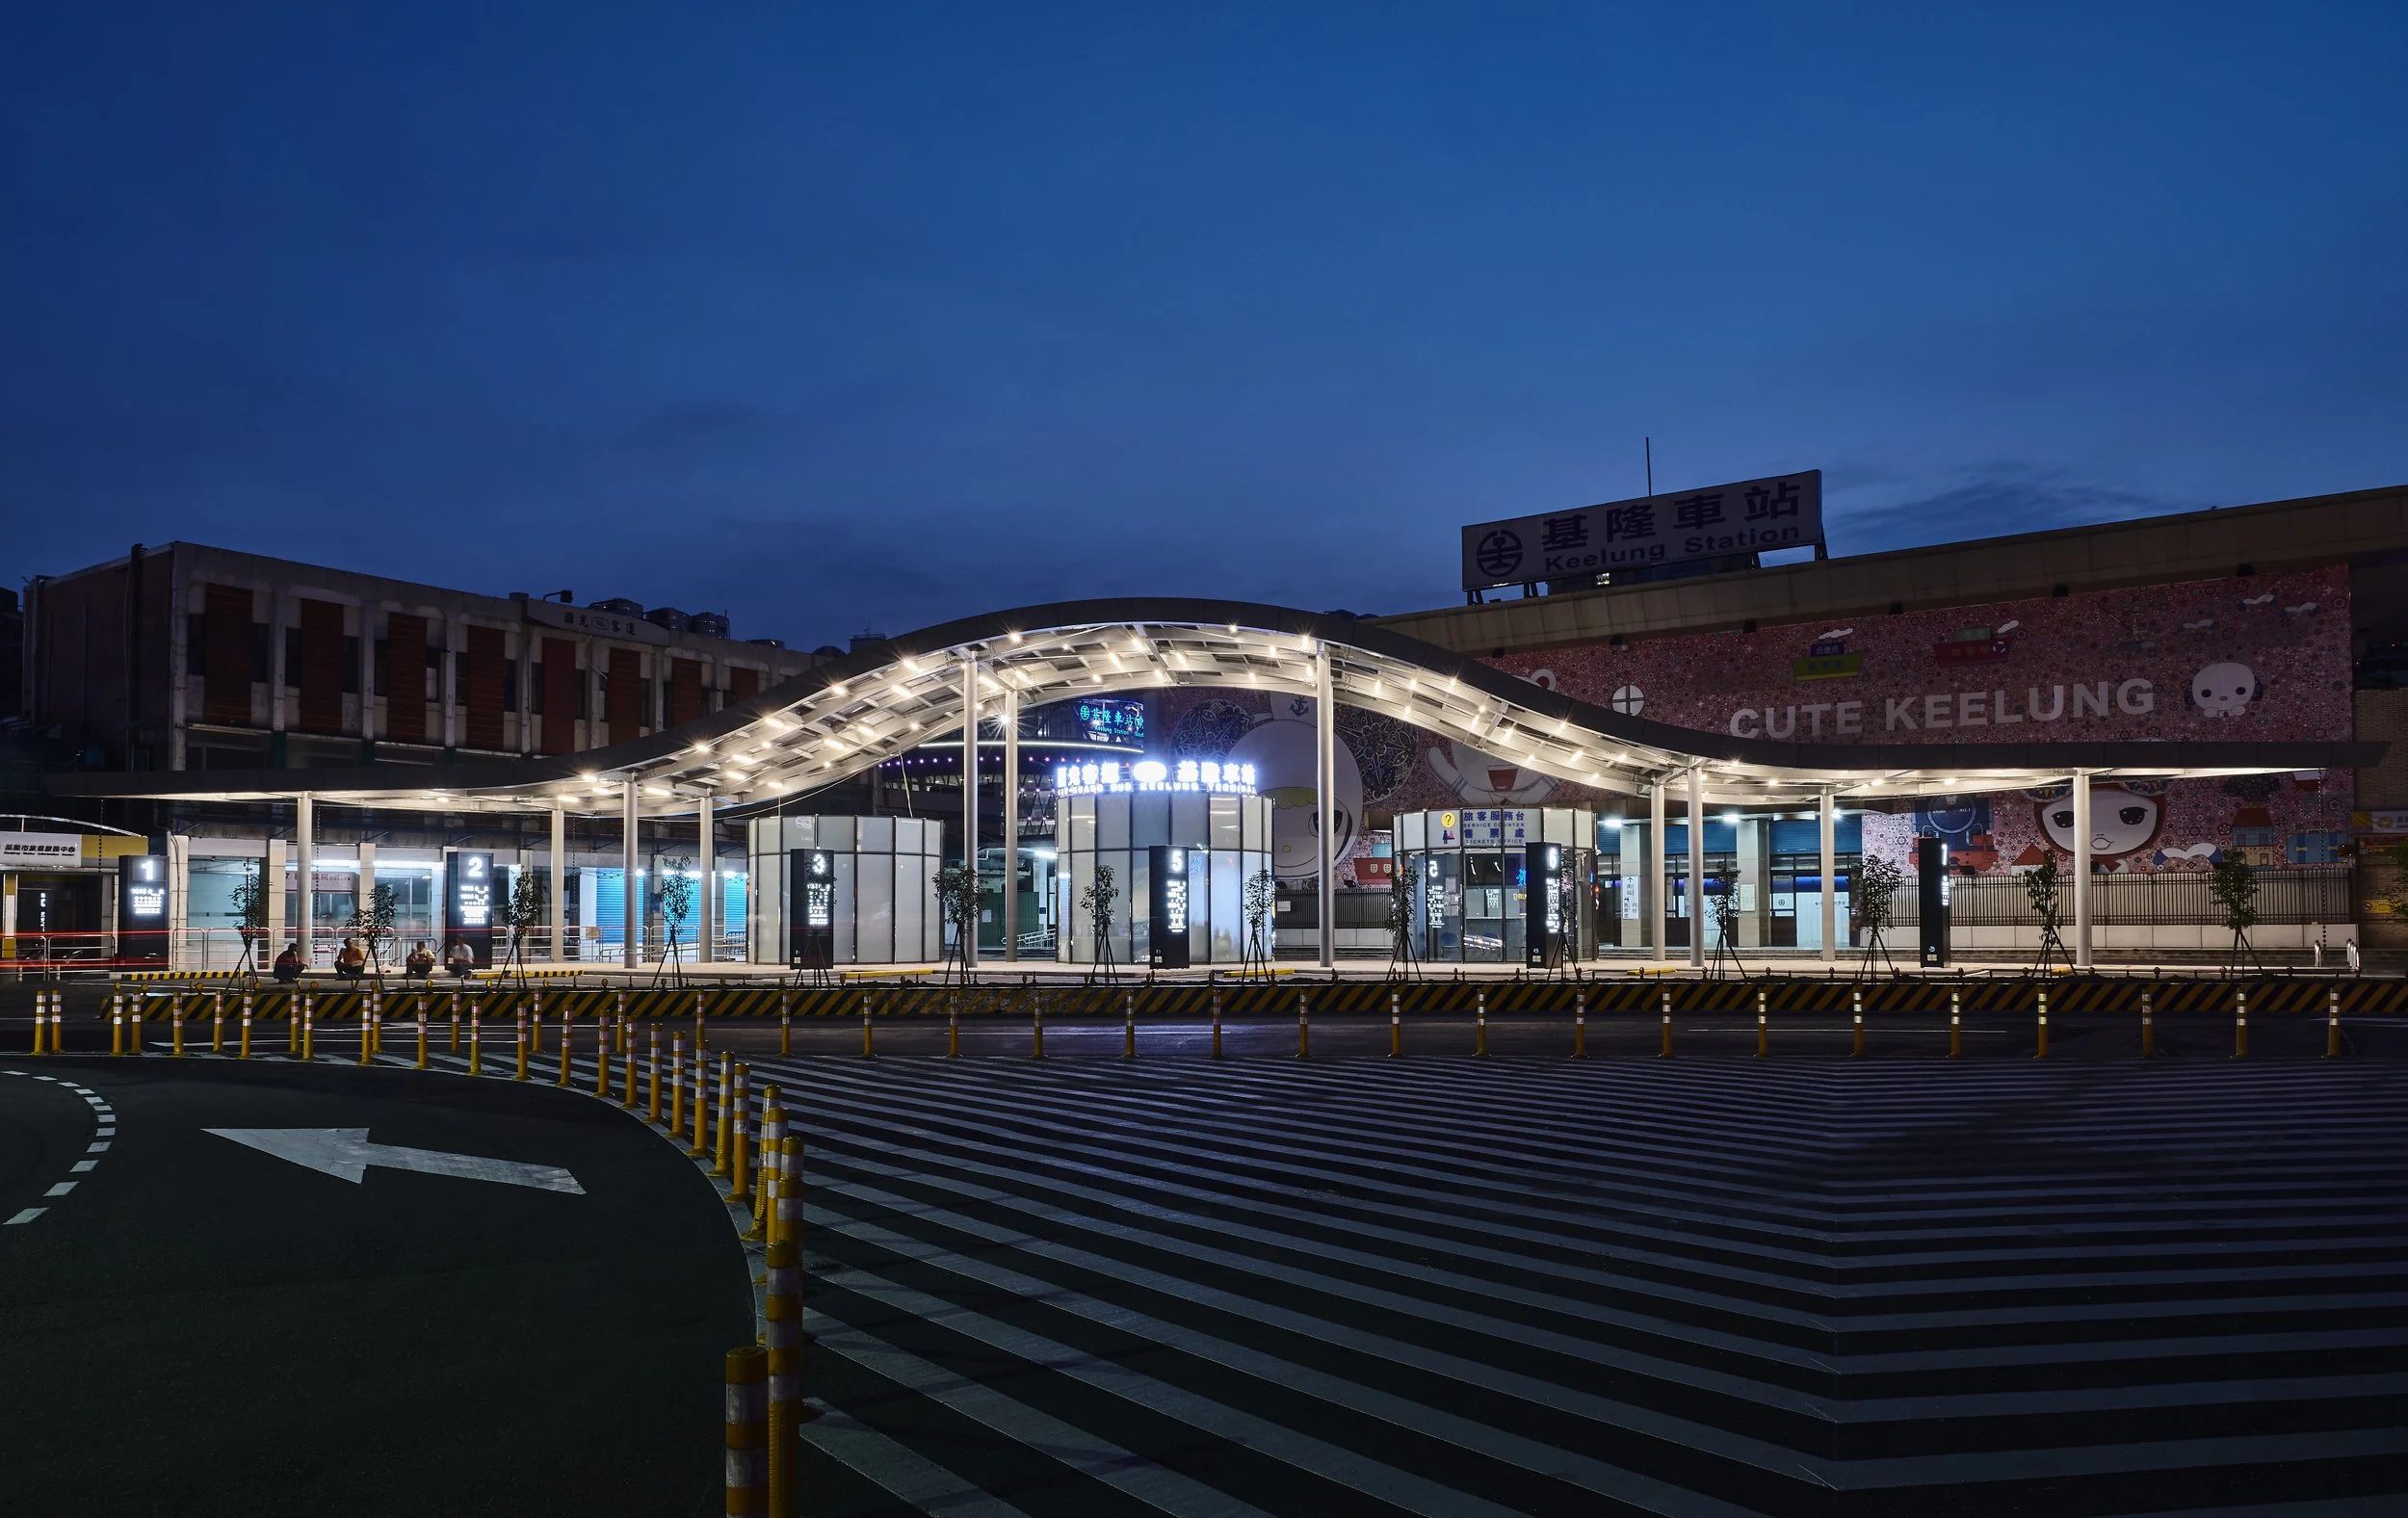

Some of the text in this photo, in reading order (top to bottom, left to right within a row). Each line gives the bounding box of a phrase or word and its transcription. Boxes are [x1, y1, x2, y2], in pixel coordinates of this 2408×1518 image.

[1540, 482, 1800, 552] 基隆車站
[1544, 526, 1799, 572] Keelung Station
[1729, 678, 2155, 739] CUTE KEELUNG
[1463, 811, 1525, 822] 旅客服務台
[468, 857, 483, 877] 2
[813, 853, 826, 875] 3
[1171, 850, 1183, 872] 5
[1549, 847, 1557, 869] 6
[141, 860, 154, 880] 1
